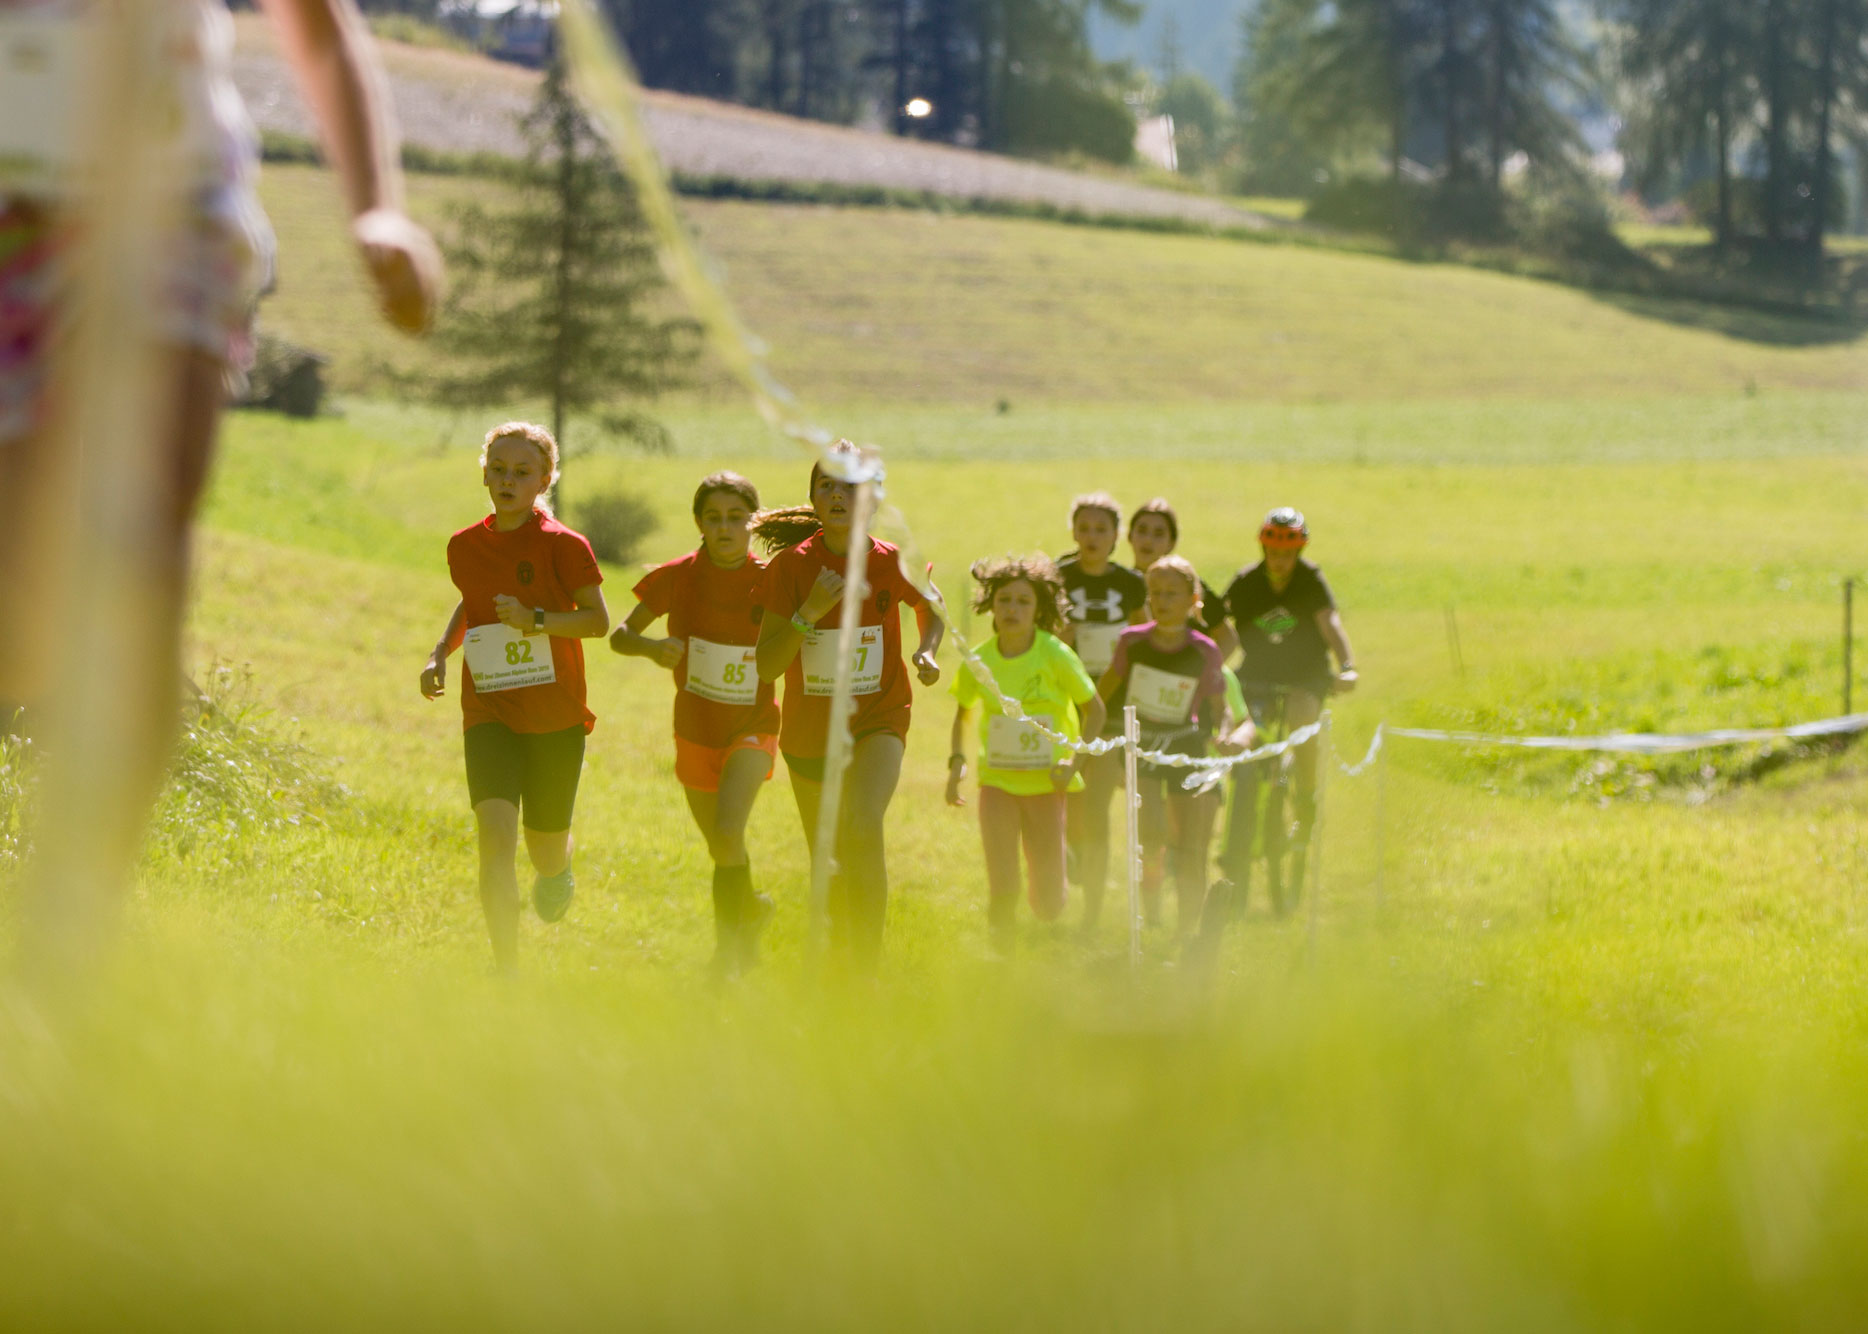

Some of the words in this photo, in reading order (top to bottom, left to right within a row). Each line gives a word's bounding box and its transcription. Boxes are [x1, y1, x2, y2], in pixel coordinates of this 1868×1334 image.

[505, 640, 534, 665] 82
[723, 663, 746, 685] 85
[1019, 732, 1040, 752] 95
